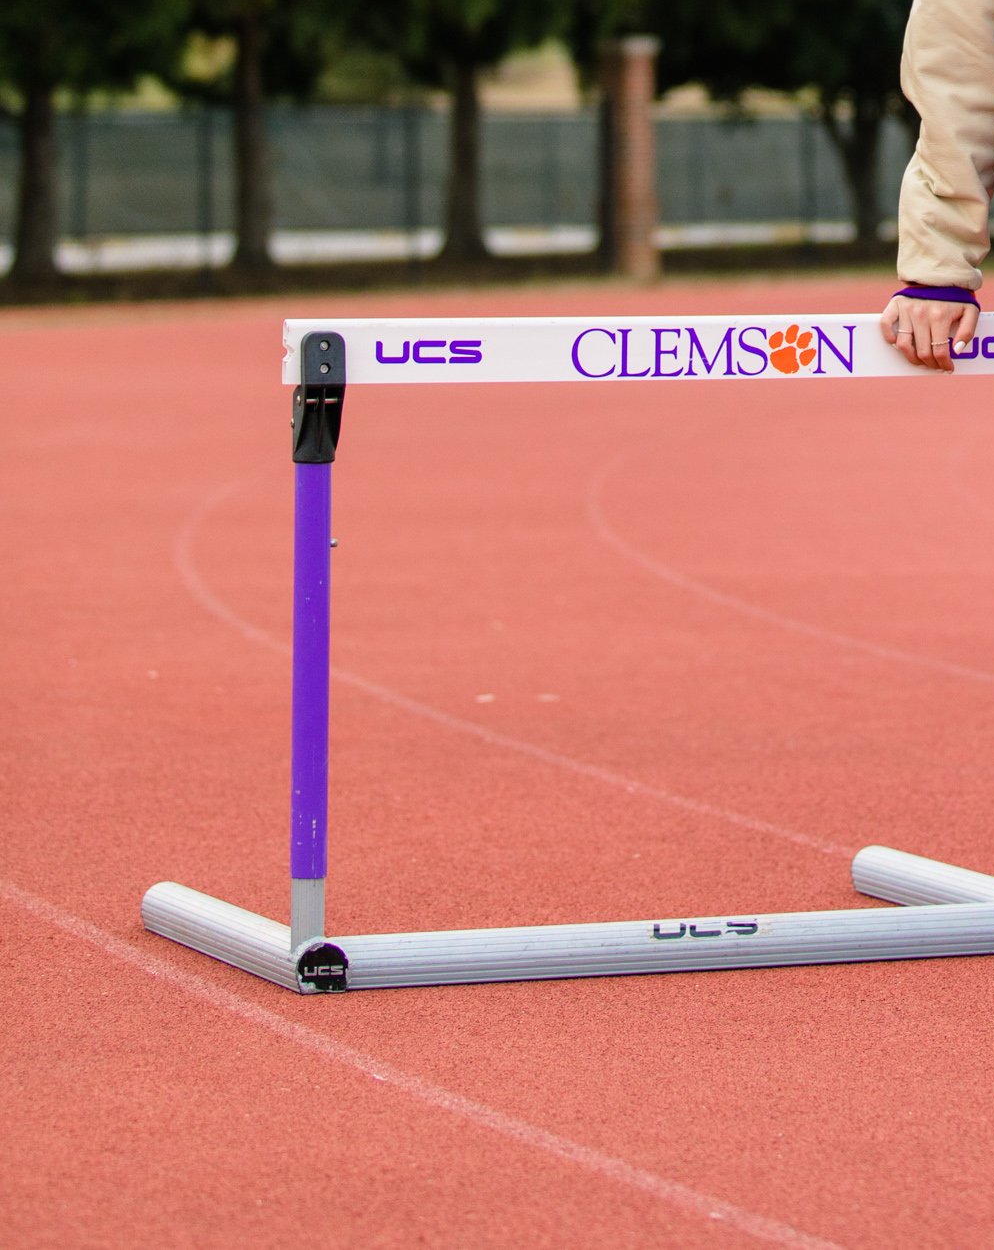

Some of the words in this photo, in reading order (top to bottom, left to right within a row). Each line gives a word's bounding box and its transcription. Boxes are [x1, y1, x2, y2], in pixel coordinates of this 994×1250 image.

[375, 340, 482, 364] UCS
[571, 324, 856, 377] CLEMSN
[304, 965, 344, 977] UCS
